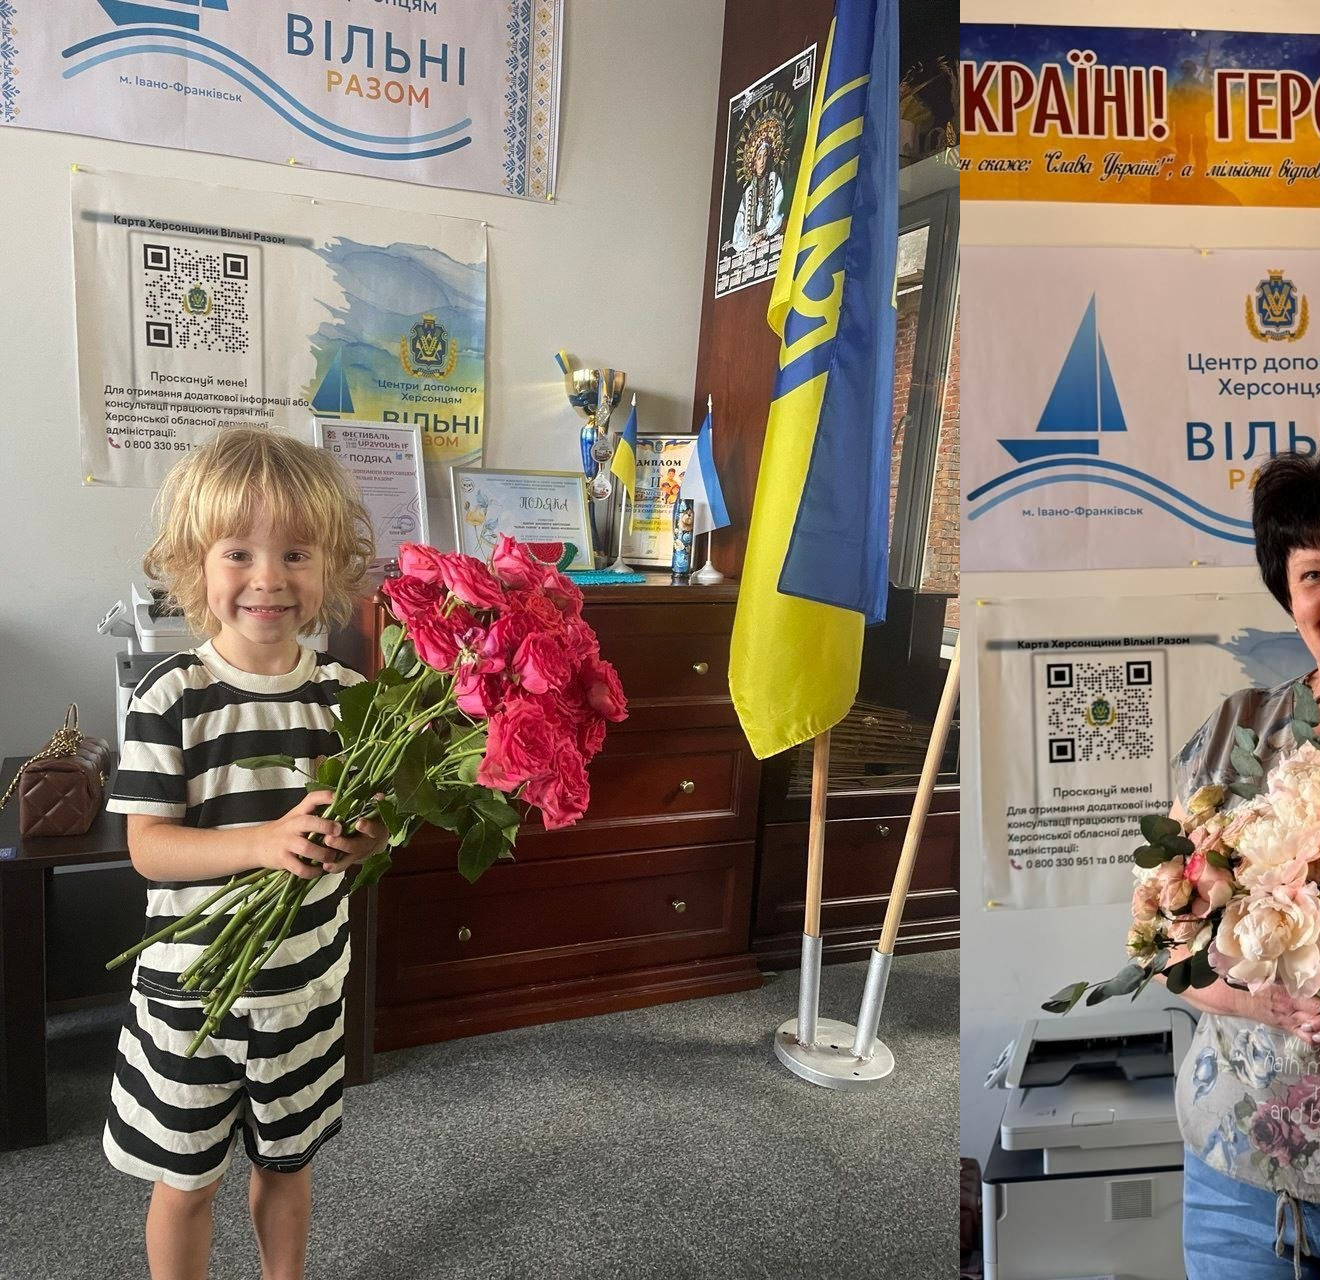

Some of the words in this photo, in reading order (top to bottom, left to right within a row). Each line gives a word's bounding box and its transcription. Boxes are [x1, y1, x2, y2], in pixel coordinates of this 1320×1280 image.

[287, 12, 466, 86] ВІЛЬНІ
[119, 75, 132, 85] м.
[135, 75, 243, 103] Івано-Франківськ
[327, 69, 429, 109] РАЗОМ
[977, 158, 1032, 172] скаже:
[1181, 165, 1192, 177] а
[1205, 160, 1272, 178] мільйони
[113, 215, 146, 228] Карта
[148, 218, 219, 236] Херсонщини
[220, 228, 252, 240] Вільні
[253, 232, 286, 245] Разом
[1187, 353, 1257, 375] Центр
[150, 371, 214, 388] Проскануй
[216, 377, 248, 388] мене!
[378, 379, 419, 391] Центри
[423, 383, 477, 394] допомоги
[104, 385, 125, 396] Для
[126, 387, 183, 399] отримання
[184, 391, 239, 403] додаткової
[239, 394, 291, 407] інформації
[292, 398, 309, 407] або
[401, 393, 462, 404] Херсонцям
[105, 399, 169, 412] консультації
[170, 403, 222, 416] працюють
[223, 407, 253, 417] гарячі
[254, 408, 275, 418] лінії
[105, 412, 169, 425] Херсонської
[171, 416, 216, 427] обласної
[383, 410, 479, 435] ВІЛЬНІ
[106, 427, 176, 439] адміністрації:
[342, 431, 390, 441] ФЕСТИВАЛЬ
[124, 440, 131, 449] 0
[133, 441, 151, 450] 800
[153, 441, 172, 450] 330
[173, 442, 191, 451] 951
[349, 453, 392, 464] ПОДЯКА
[636, 459, 682, 467] ДИПЛОМ
[519, 496, 569, 512] ПОДЯКА
[1022, 509, 1034, 517] м.
[1037, 506, 1144, 518] Івано-Франківськ
[1017, 640, 1049, 650] Карта
[1051, 639, 1121, 650] Херсонщини
[1123, 637, 1155, 647] Вільні
[1157, 636, 1190, 645] Разом
[1053, 785, 1118, 800] Проскануй
[1120, 784, 1153, 795] мене!
[1007, 806, 1027, 816] Для
[1029, 804, 1085, 815] отримання
[1087, 800, 1144, 813] додаткової
[1007, 817, 1071, 830] консультації
[1072, 815, 1126, 828] працюють
[1007, 830, 1072, 843] Херсонської
[1073, 828, 1121, 839] обласної
[1007, 844, 1079, 857] адміністрації:
[1026, 860, 1033, 869] 0
[1034, 859, 1054, 869] 800
[1055, 858, 1075, 868] 330
[1076, 857, 1094, 866] 951
[1096, 857, 1107, 865] та
[1109, 856, 1116, 864] 0
[1117, 855, 1136, 864] 800
[1270, 1102, 1304, 1126] and
